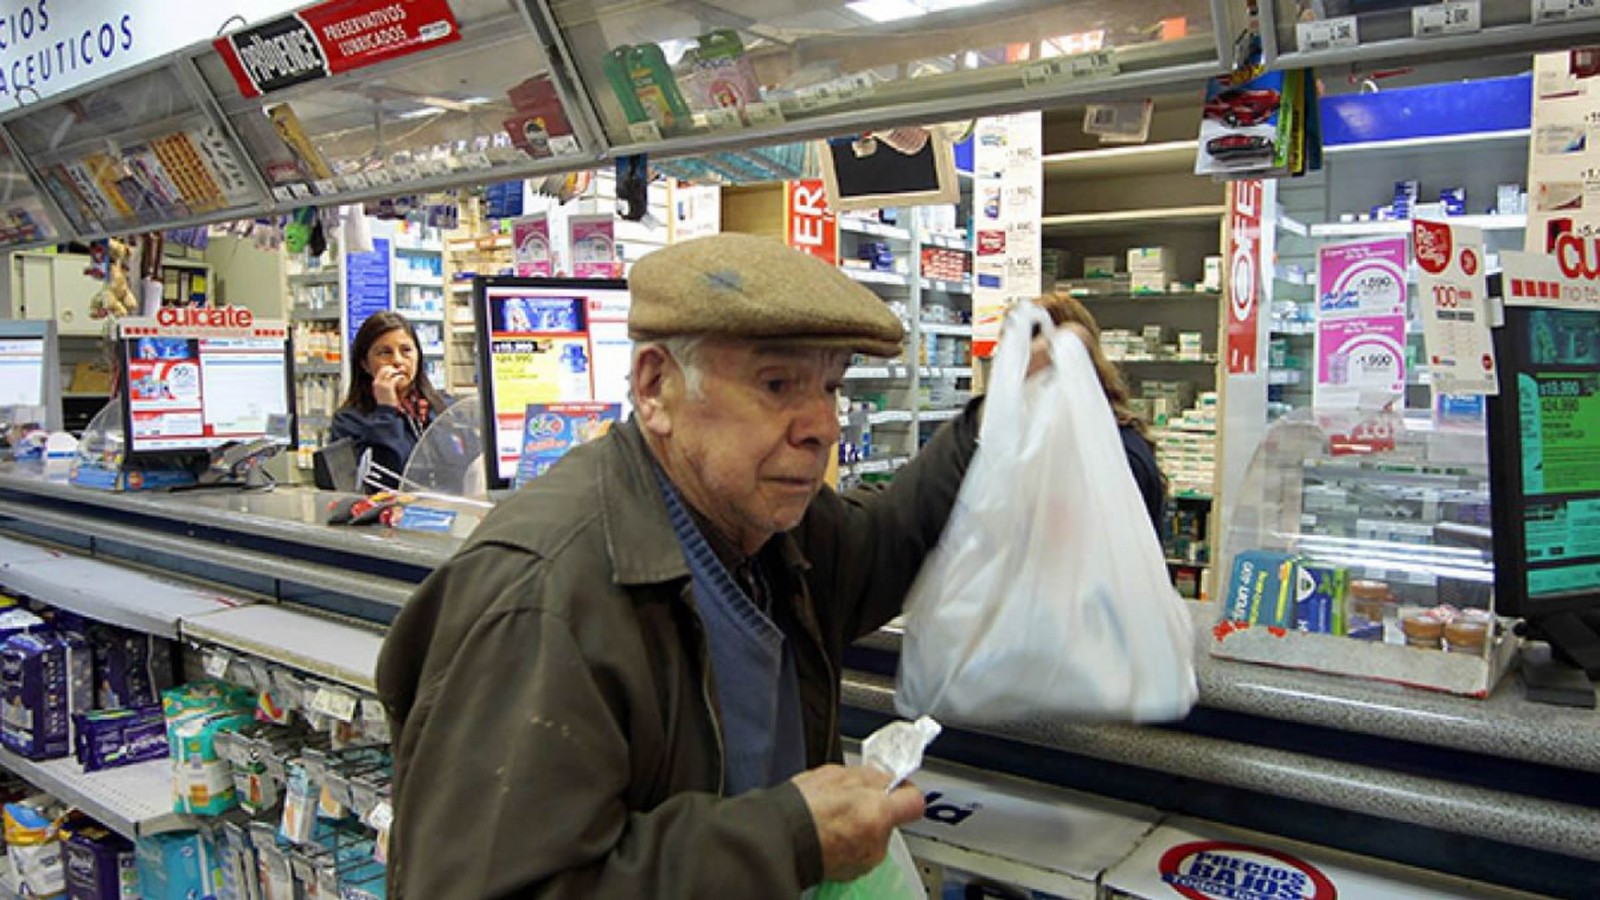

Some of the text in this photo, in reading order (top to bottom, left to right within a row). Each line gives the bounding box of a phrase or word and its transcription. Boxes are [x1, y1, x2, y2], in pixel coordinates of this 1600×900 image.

[157, 304, 253, 328] cuidate
[1188, 862, 1304, 900] BAJOS
[1195, 851, 1306, 886] PRECIOS
